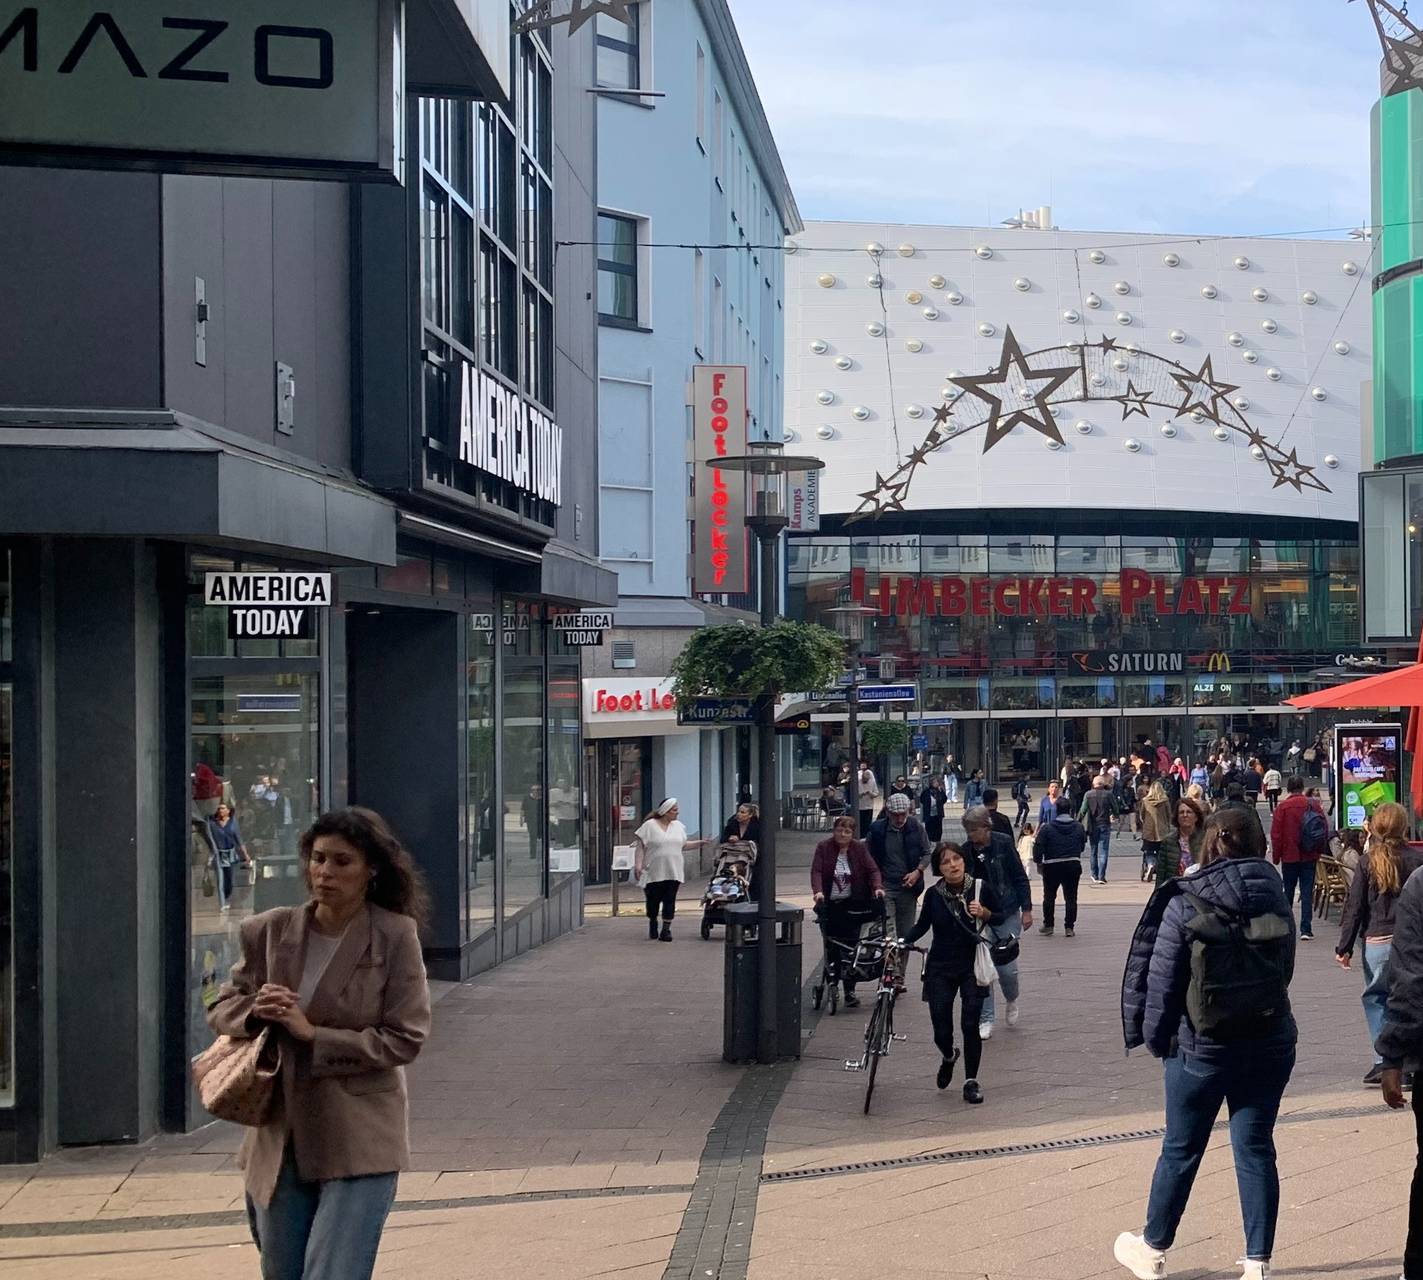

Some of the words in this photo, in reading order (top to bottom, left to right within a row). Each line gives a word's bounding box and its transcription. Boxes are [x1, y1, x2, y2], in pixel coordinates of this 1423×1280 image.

[710, 373, 729, 456] Foot
[459, 360, 530, 491] AMERICA
[530, 406, 563, 506] TODAY
[791, 488, 804, 529] Kamps
[209, 575, 327, 602] AMERICA
[851, 567, 1097, 617] LIMBECKER
[1120, 567, 1251, 616] PLATZ
[232, 609, 304, 635] TODAY
[555, 615, 610, 628] AMERICA
[566, 631, 600, 645] TODAY
[1108, 653, 1183, 672] SATURN
[597, 689, 643, 712] Foot
[689, 706, 753, 719] Kunzestr.
